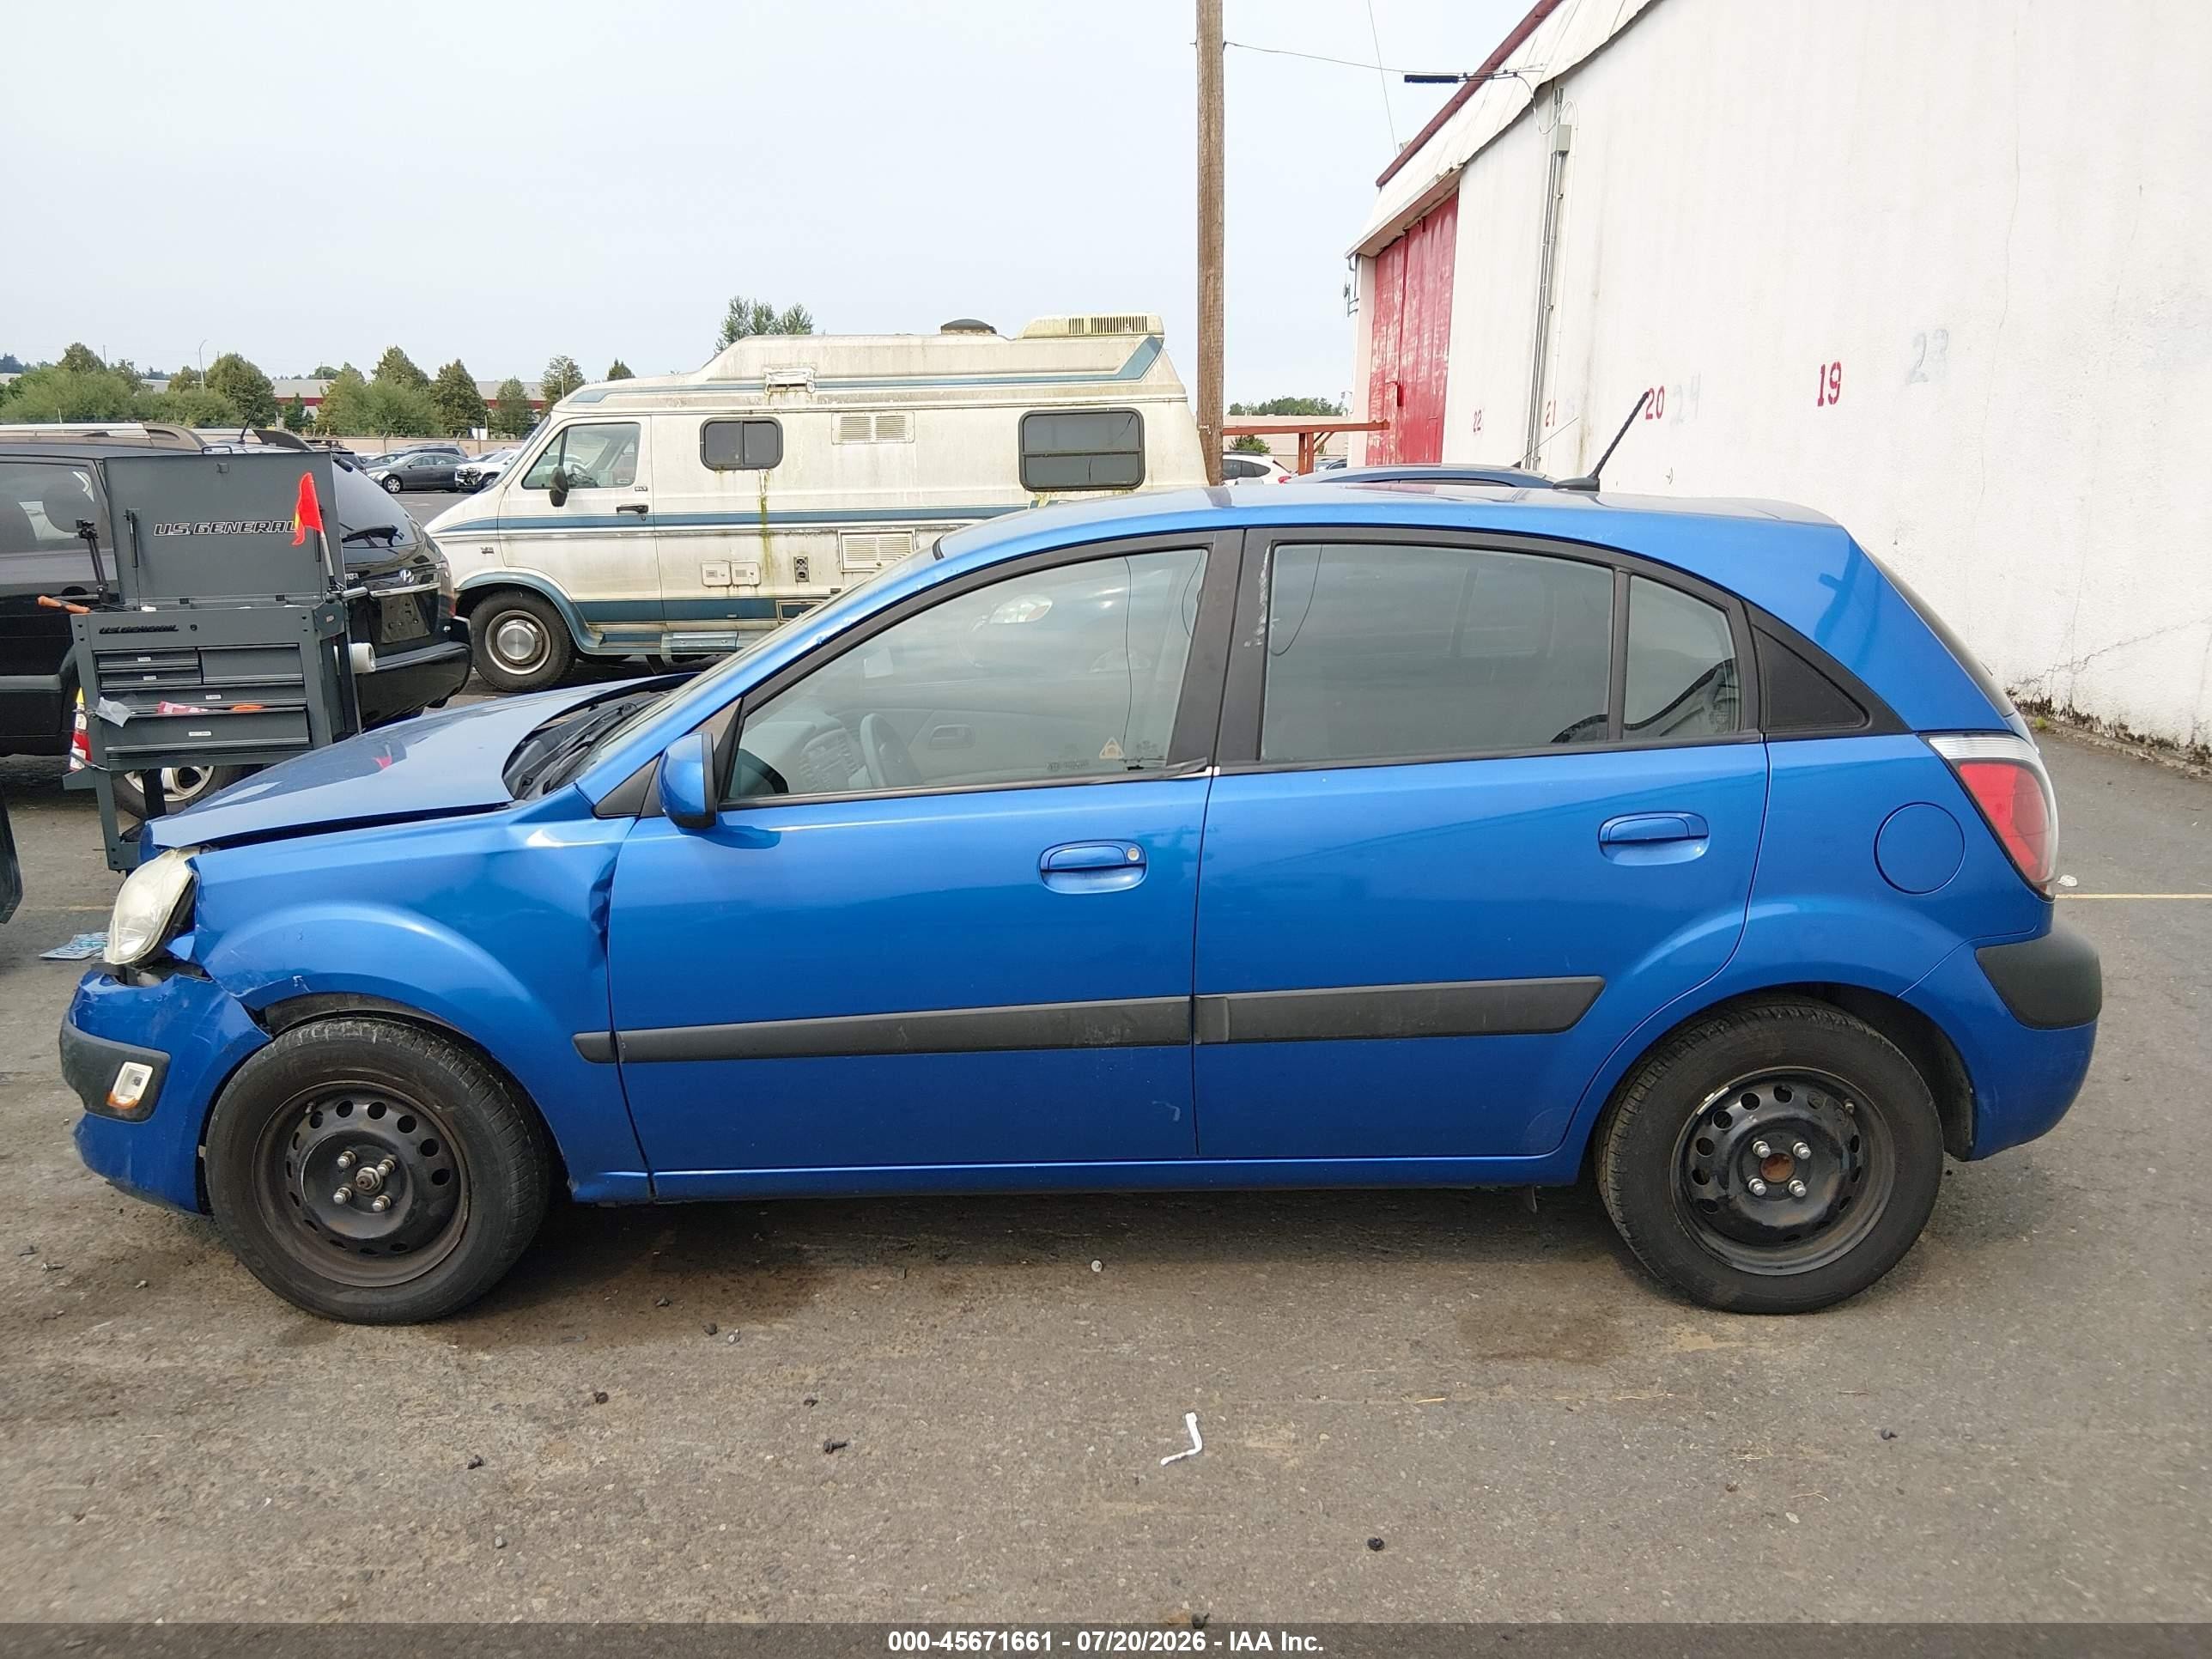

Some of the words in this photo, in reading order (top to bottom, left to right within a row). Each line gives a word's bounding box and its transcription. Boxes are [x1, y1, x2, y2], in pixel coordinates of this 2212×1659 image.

[1817, 361, 1842, 407] 19
[1545, 399, 1557, 428] 21
[1644, 385, 1665, 420] 20
[1473, 409, 1482, 433] 22
